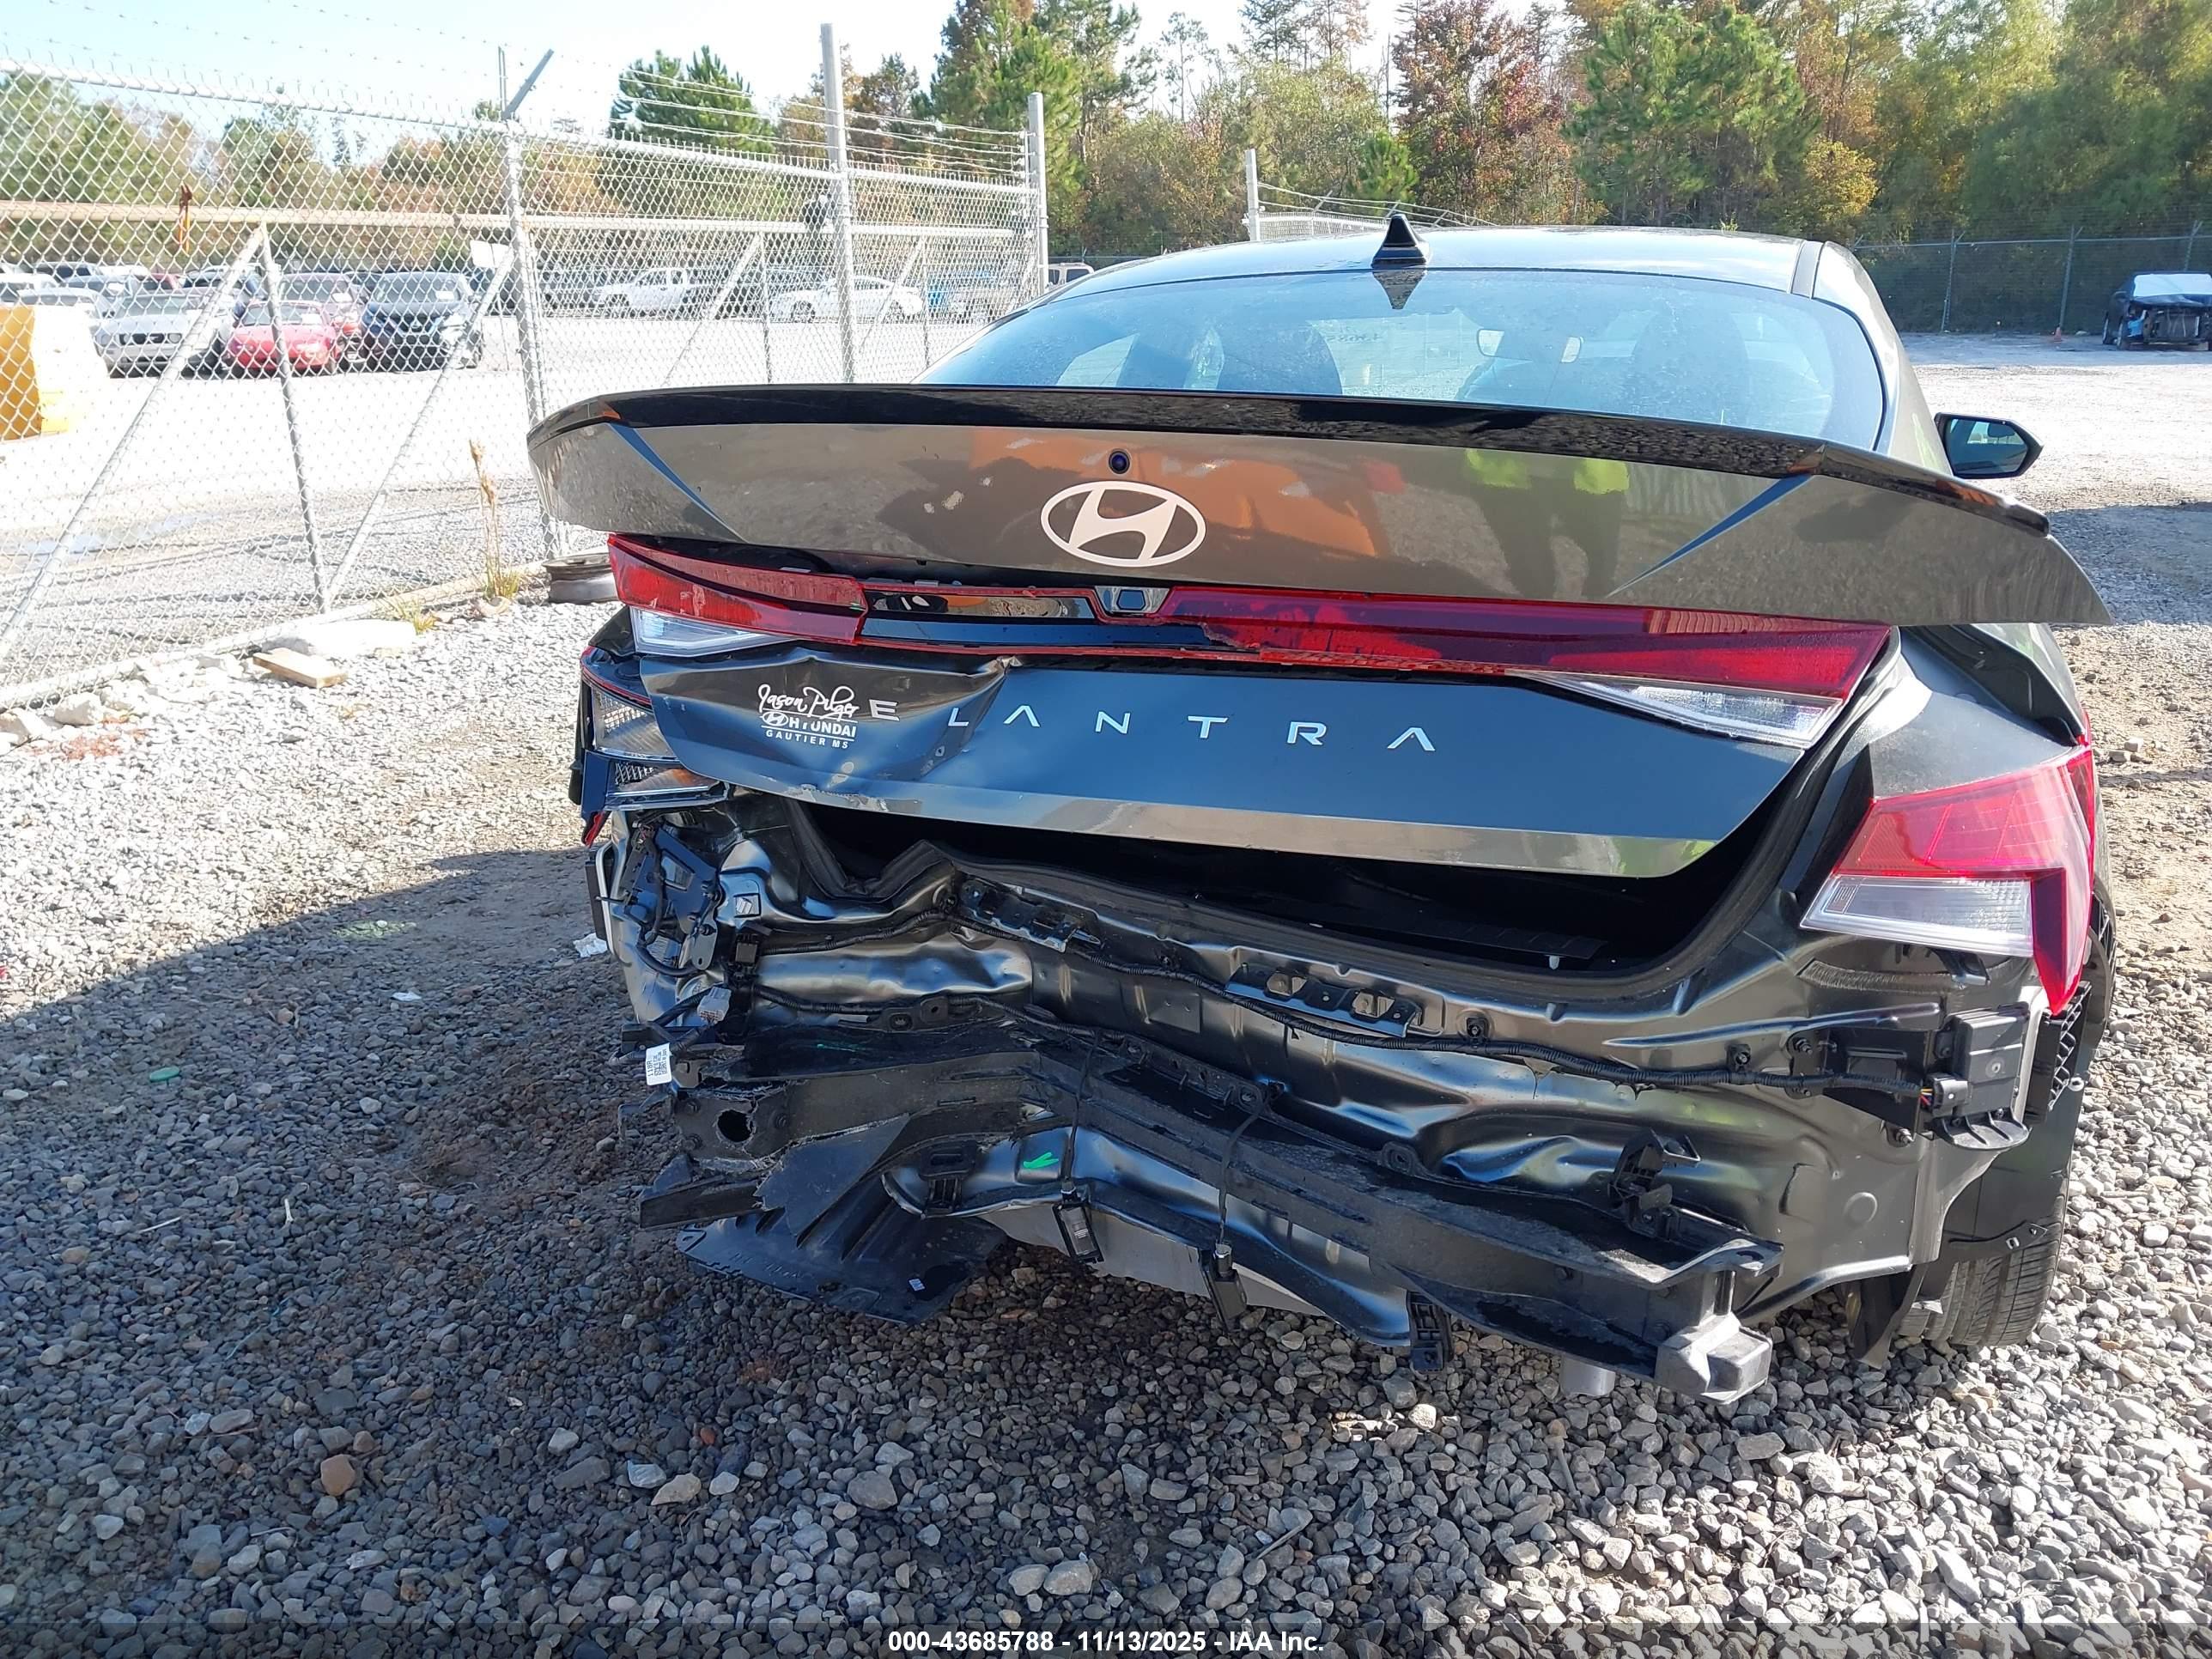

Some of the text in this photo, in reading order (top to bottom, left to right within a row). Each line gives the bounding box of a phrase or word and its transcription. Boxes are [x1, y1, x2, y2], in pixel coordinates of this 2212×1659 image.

[757, 684, 808, 713] Jason
[766, 730, 849, 749] GAUTIER MS
[869, 699, 1436, 751] ELANTRA
